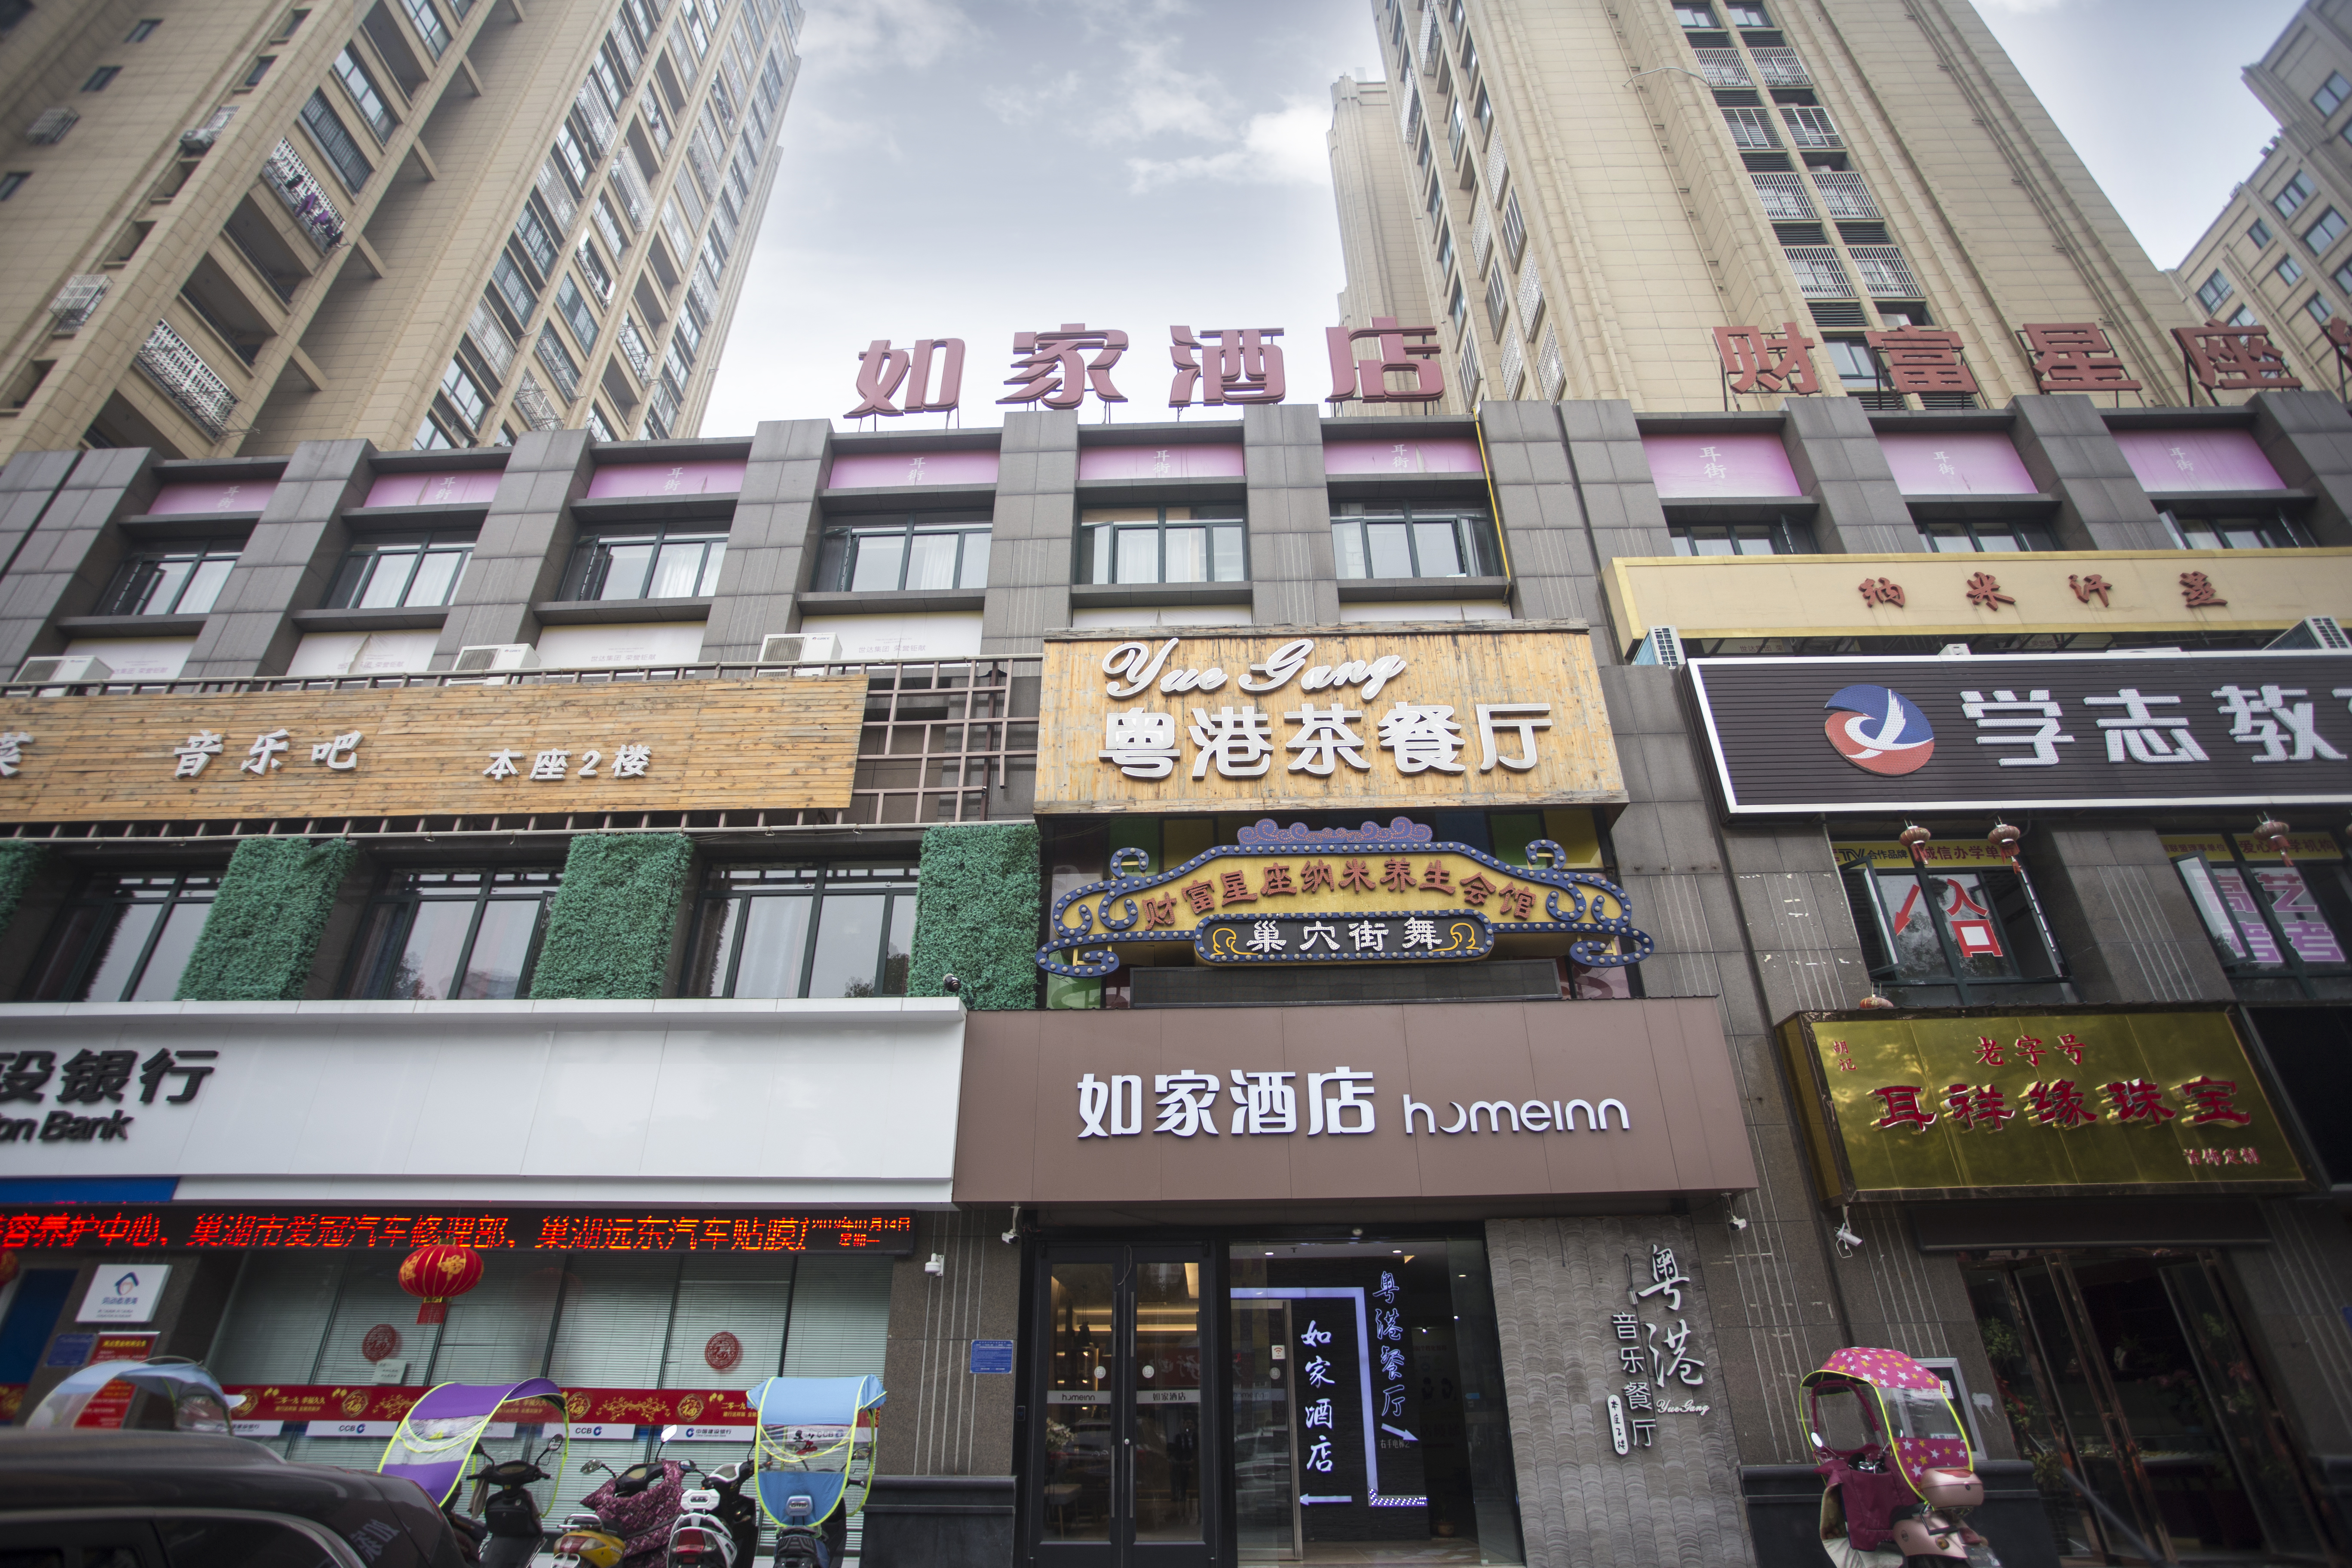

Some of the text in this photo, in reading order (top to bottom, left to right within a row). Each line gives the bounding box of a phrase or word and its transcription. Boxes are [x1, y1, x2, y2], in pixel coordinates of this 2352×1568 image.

[843, 317, 1444, 417] 如家酒店
[907, 457, 925, 481] 耳街
[1153, 450, 1170, 474] 耳街
[1392, 444, 1409, 469] 耳街
[1699, 447, 1727, 479] 耳街
[1933, 451, 1955, 476] 耳街
[2168, 447, 2195, 473] 耳街
[663, 467, 683, 491] 耳街
[1858, 571, 2227, 611] 纳米汗蒸
[1101, 637, 1407, 702] Yue Gang
[1098, 701, 1552, 781] 粤港茶餐厅
[1960, 685, 2352, 766] 学志教
[173, 729, 363, 779] 音乐吧
[483, 745, 650, 782] 本座2楼
[1867, 849, 1908, 859] 合作品牌
[2239, 839, 2337, 853] 爱心学机构
[1142, 858, 1537, 931] 财富星座纳米养生会馆
[1247, 917, 1442, 953] 巢穴街舞
[1946, 879, 2003, 958] 入口
[1832, 1040, 1857, 1072] 胡记
[1972, 1034, 2086, 1067] 老字号
[0, 1048, 218, 1104] 设银行
[1078, 1066, 1376, 1139] 如家酒店
[1865, 1075, 2251, 1133] 耳祥缘珠宝
[39, 1109, 135, 1142] Bank
[2183, 1146, 2260, 1166] 首饰定制
[1638, 1244, 1705, 1387] 粤港
[1373, 1271, 1405, 1417] 粤港餐厅
[1612, 1311, 1657, 1447] 音乐餐厅
[346, 1395, 364, 1412] 福
[570, 1396, 585, 1415] 福
[683, 1399, 698, 1417] 福
[1153, 1392, 1185, 1401] 如家酒店
[1301, 1320, 1335, 1472] 如家酒店
